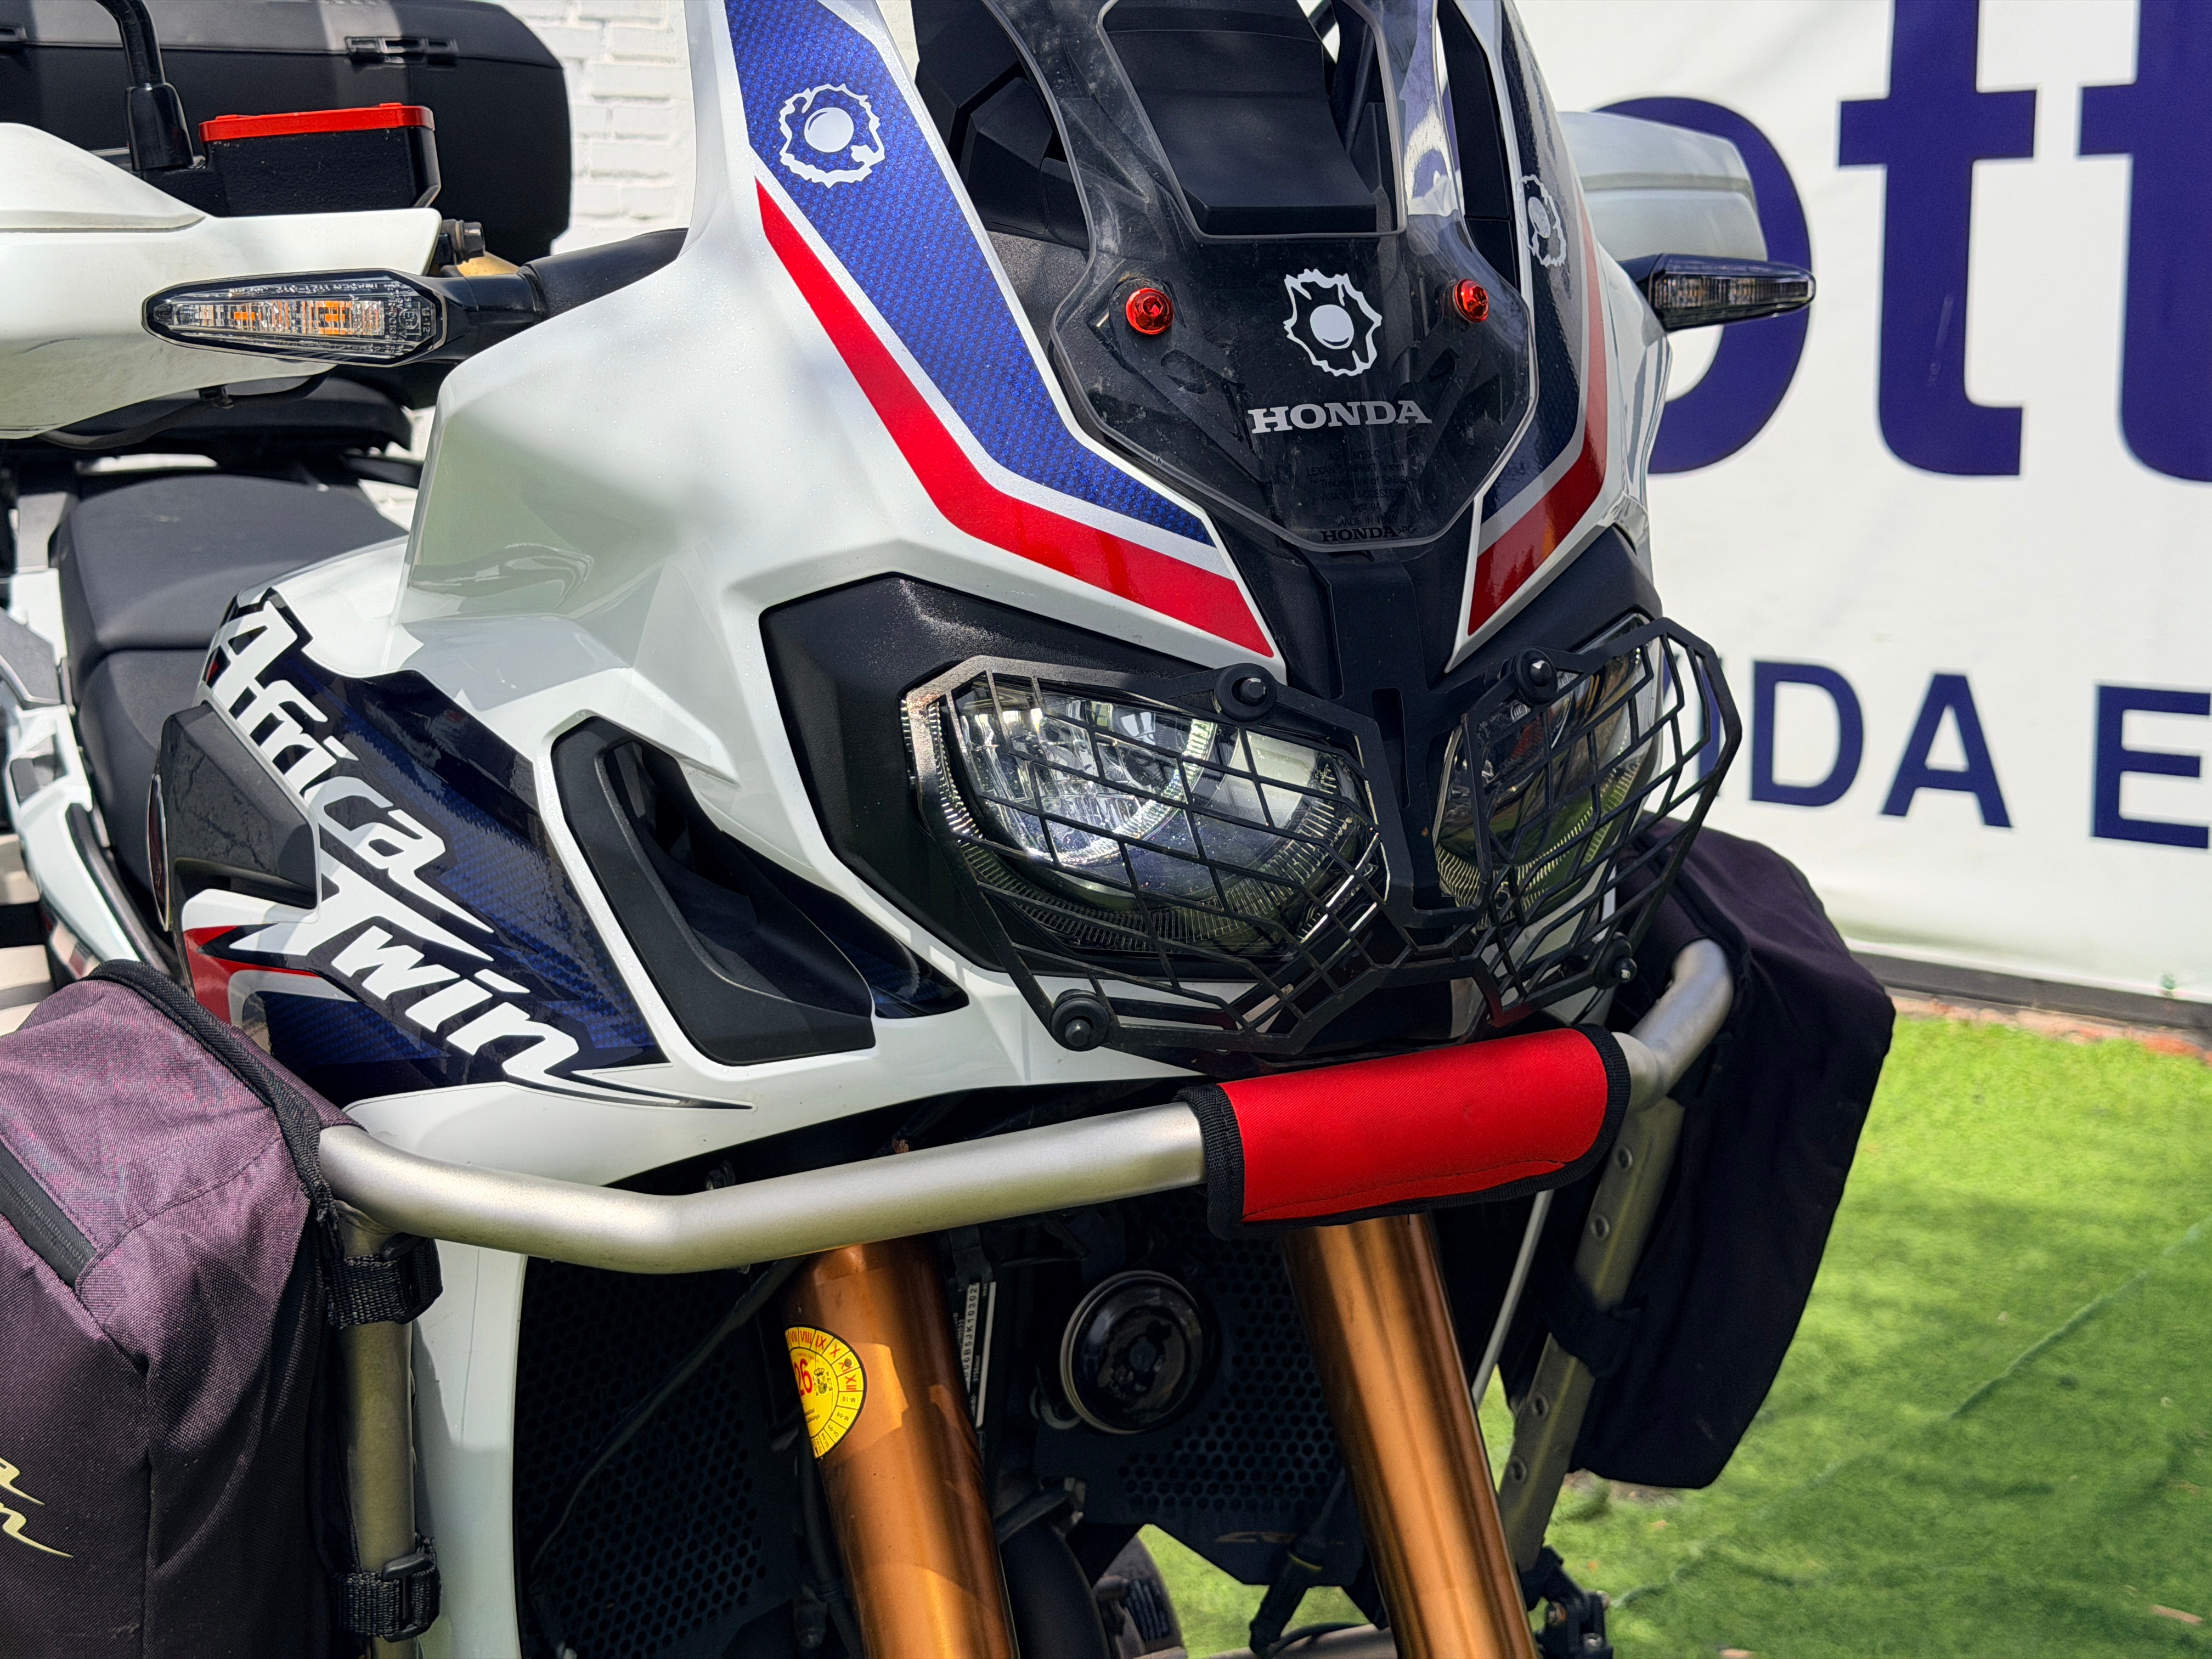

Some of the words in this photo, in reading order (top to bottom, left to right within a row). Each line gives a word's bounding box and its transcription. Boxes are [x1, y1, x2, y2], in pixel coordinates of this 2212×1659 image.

[1248, 400, 1432, 434] HONDA
[1320, 525, 1399, 542] HONDA
[206, 599, 495, 934] Africa
[229, 848, 683, 1105] Twin
[799, 1329, 812, 1344] VIII
[815, 1334, 827, 1350] IX
[829, 1343, 842, 1359] X
[844, 1374, 857, 1390] XII
